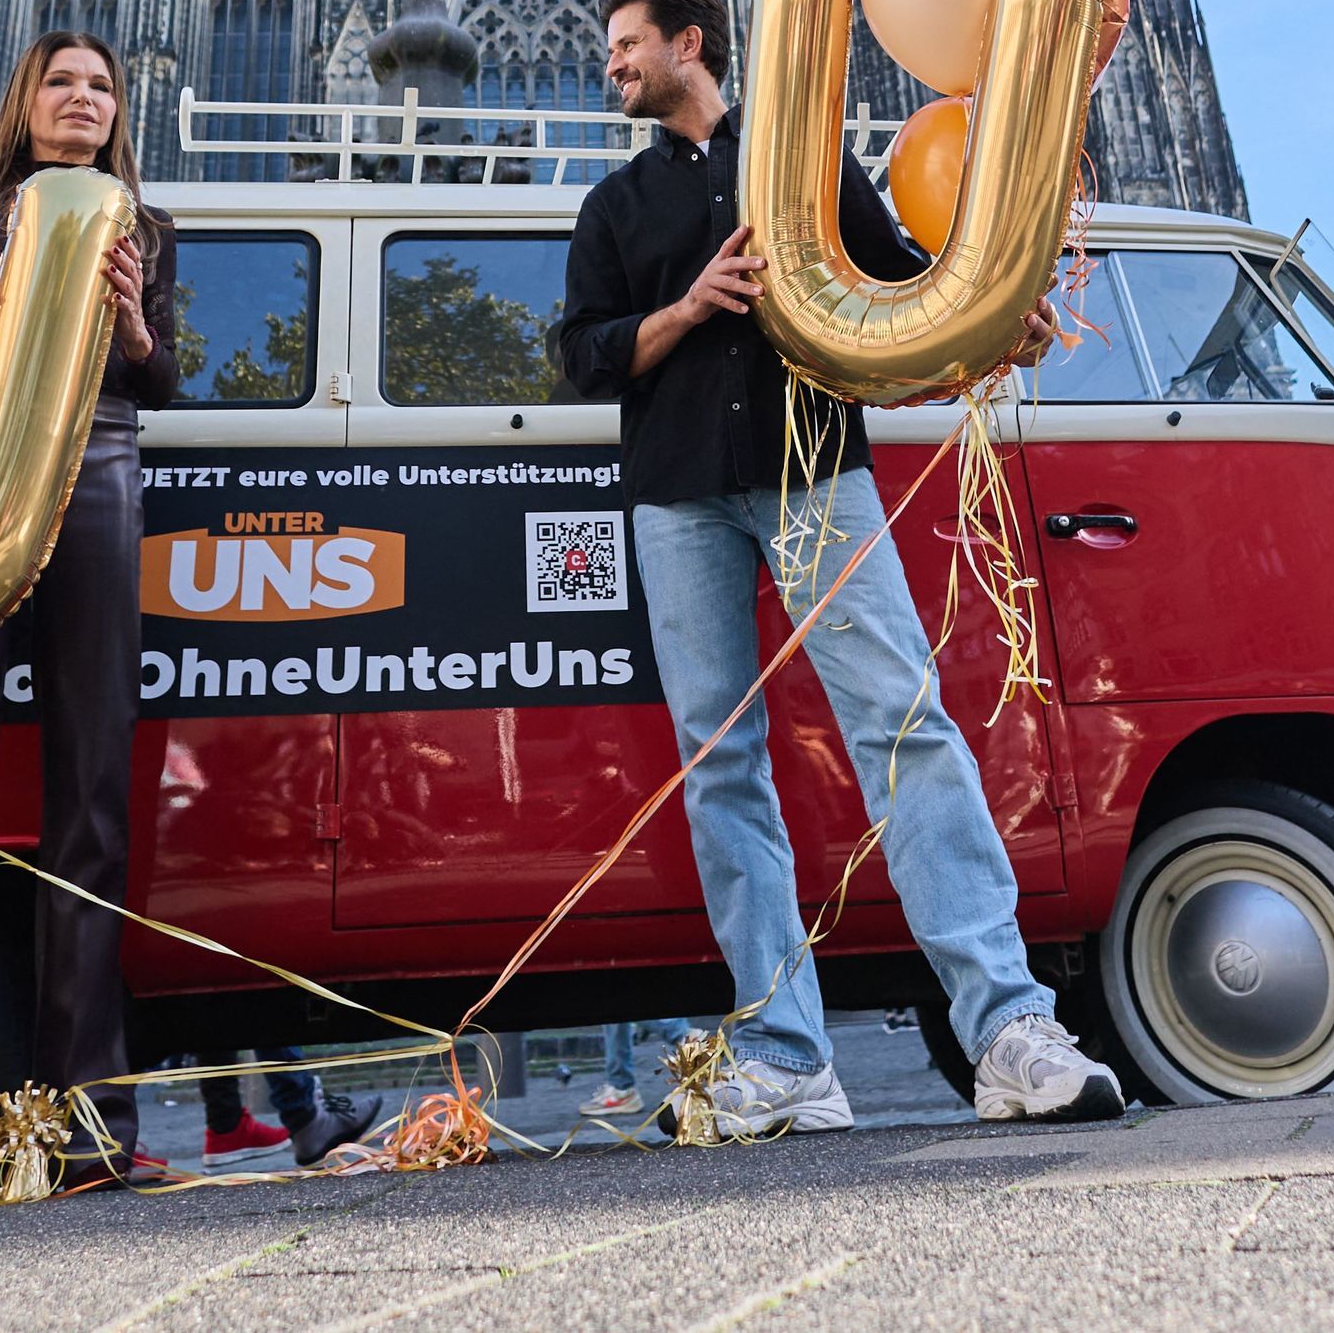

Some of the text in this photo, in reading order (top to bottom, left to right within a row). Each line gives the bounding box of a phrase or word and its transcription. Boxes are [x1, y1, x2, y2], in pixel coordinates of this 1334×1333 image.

[141, 463, 621, 488] JETZT eure volle Unterstützung!
[224, 512, 324, 533] UNTER
[168, 537, 377, 612] UNS
